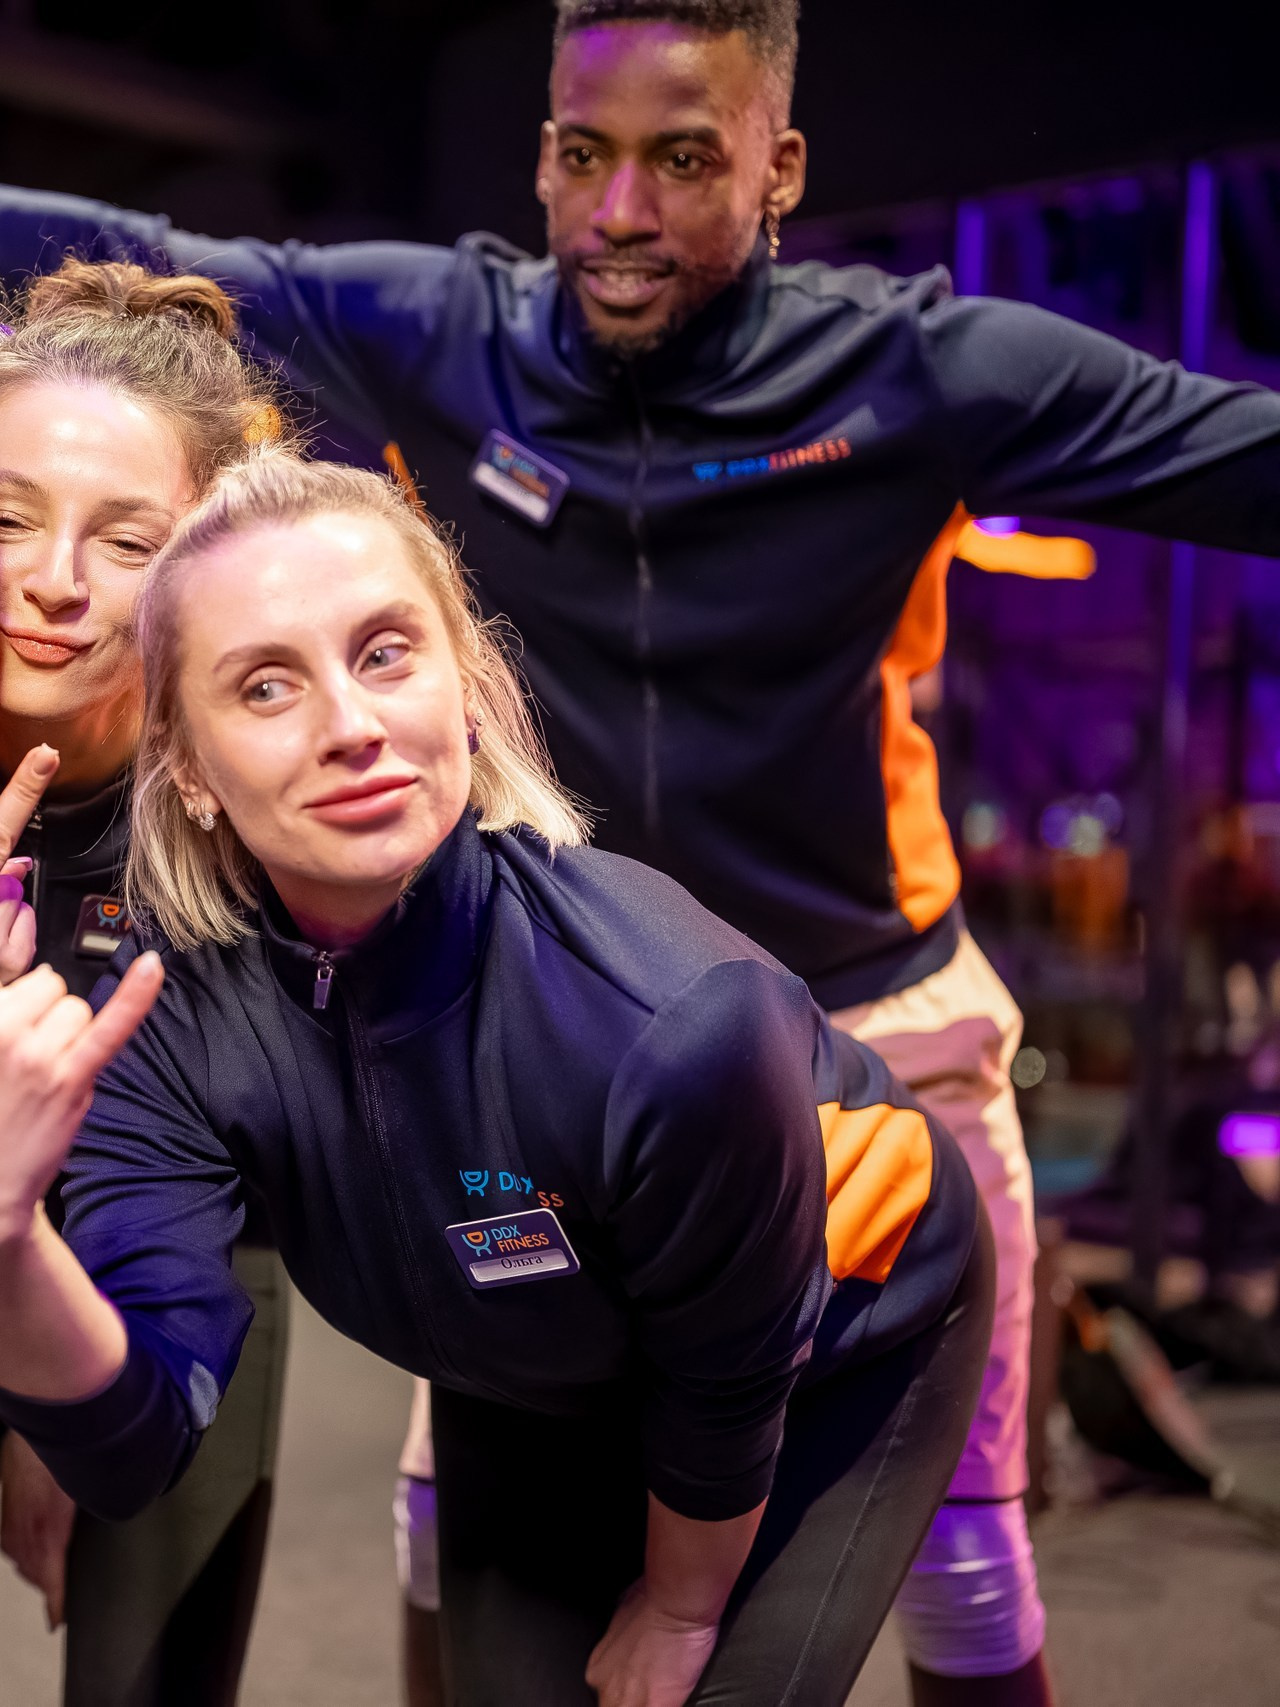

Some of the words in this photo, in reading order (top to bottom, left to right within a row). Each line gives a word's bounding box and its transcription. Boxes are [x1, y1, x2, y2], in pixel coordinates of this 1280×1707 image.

[491, 1225, 522, 1240] DDX
[497, 1233, 549, 1252] FITNESS
[501, 1255, 543, 1269] Ольга
